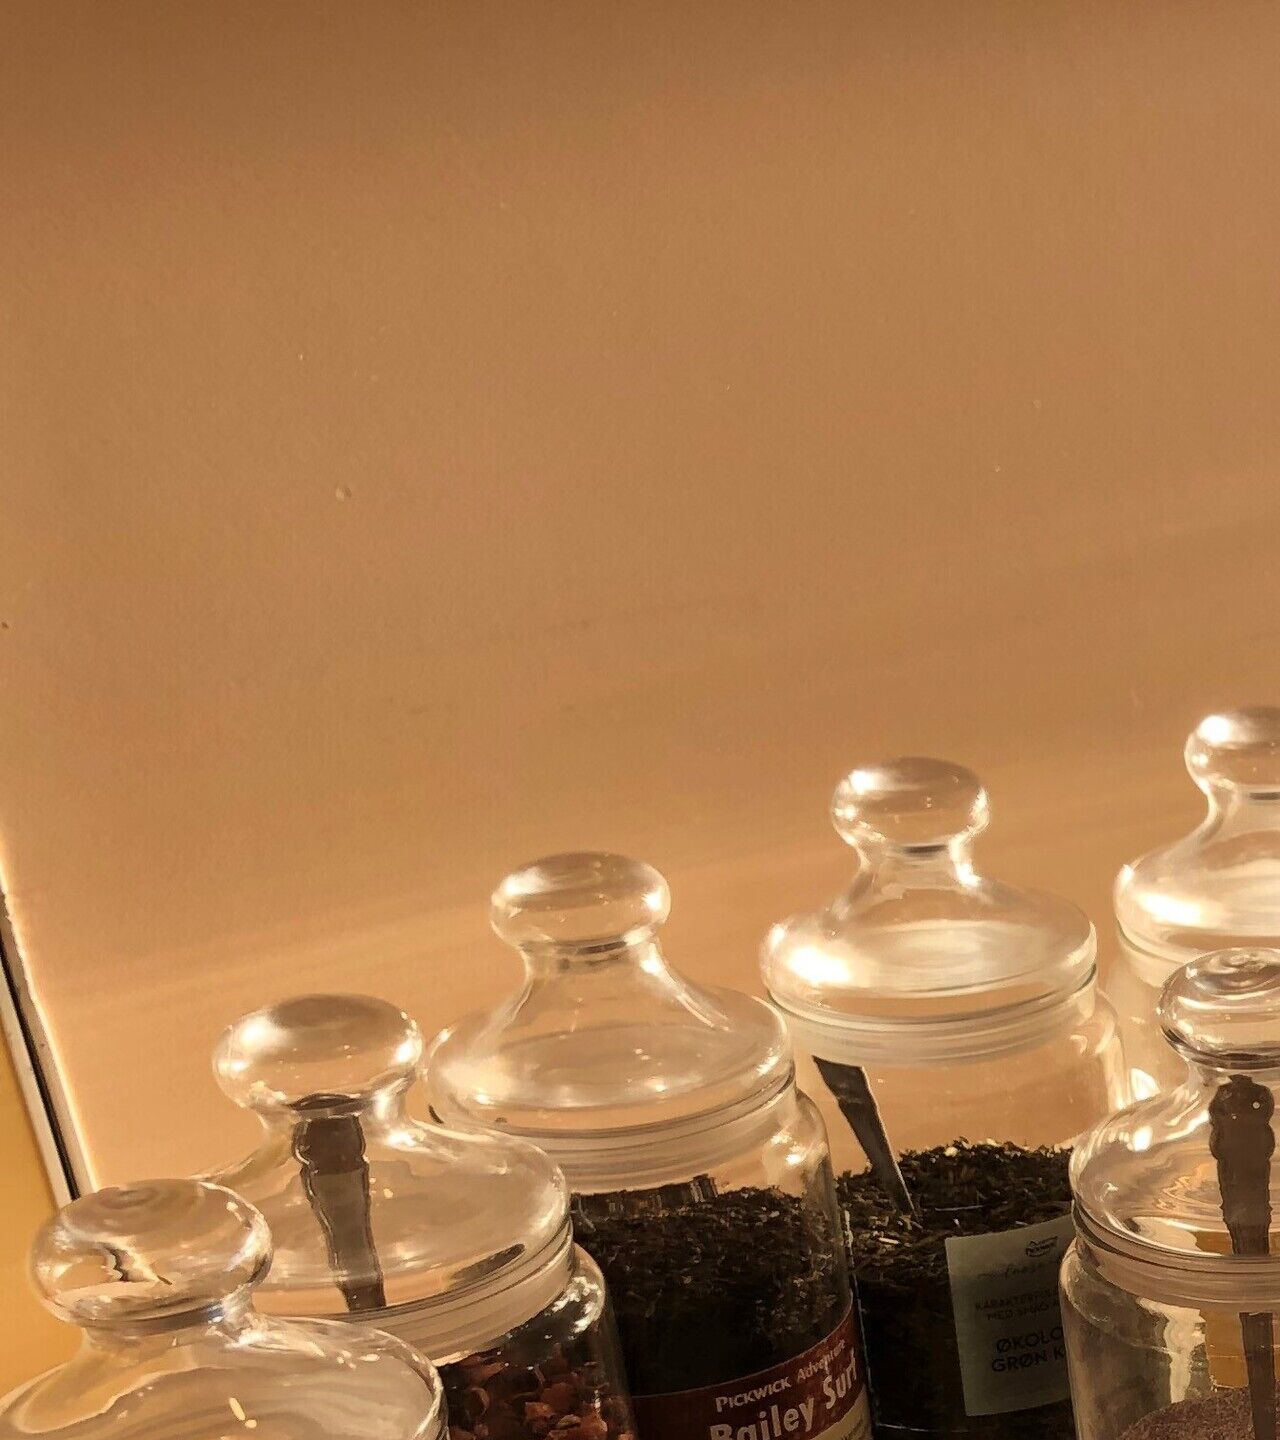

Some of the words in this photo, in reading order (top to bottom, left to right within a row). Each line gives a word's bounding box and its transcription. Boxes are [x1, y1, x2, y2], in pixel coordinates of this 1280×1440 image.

[995, 1325, 1063, 1354] ØKOLO
[990, 1351, 1049, 1374] GRØN
[1052, 1346, 1066, 1362] K
[714, 1376, 793, 1414] PICKWICK
